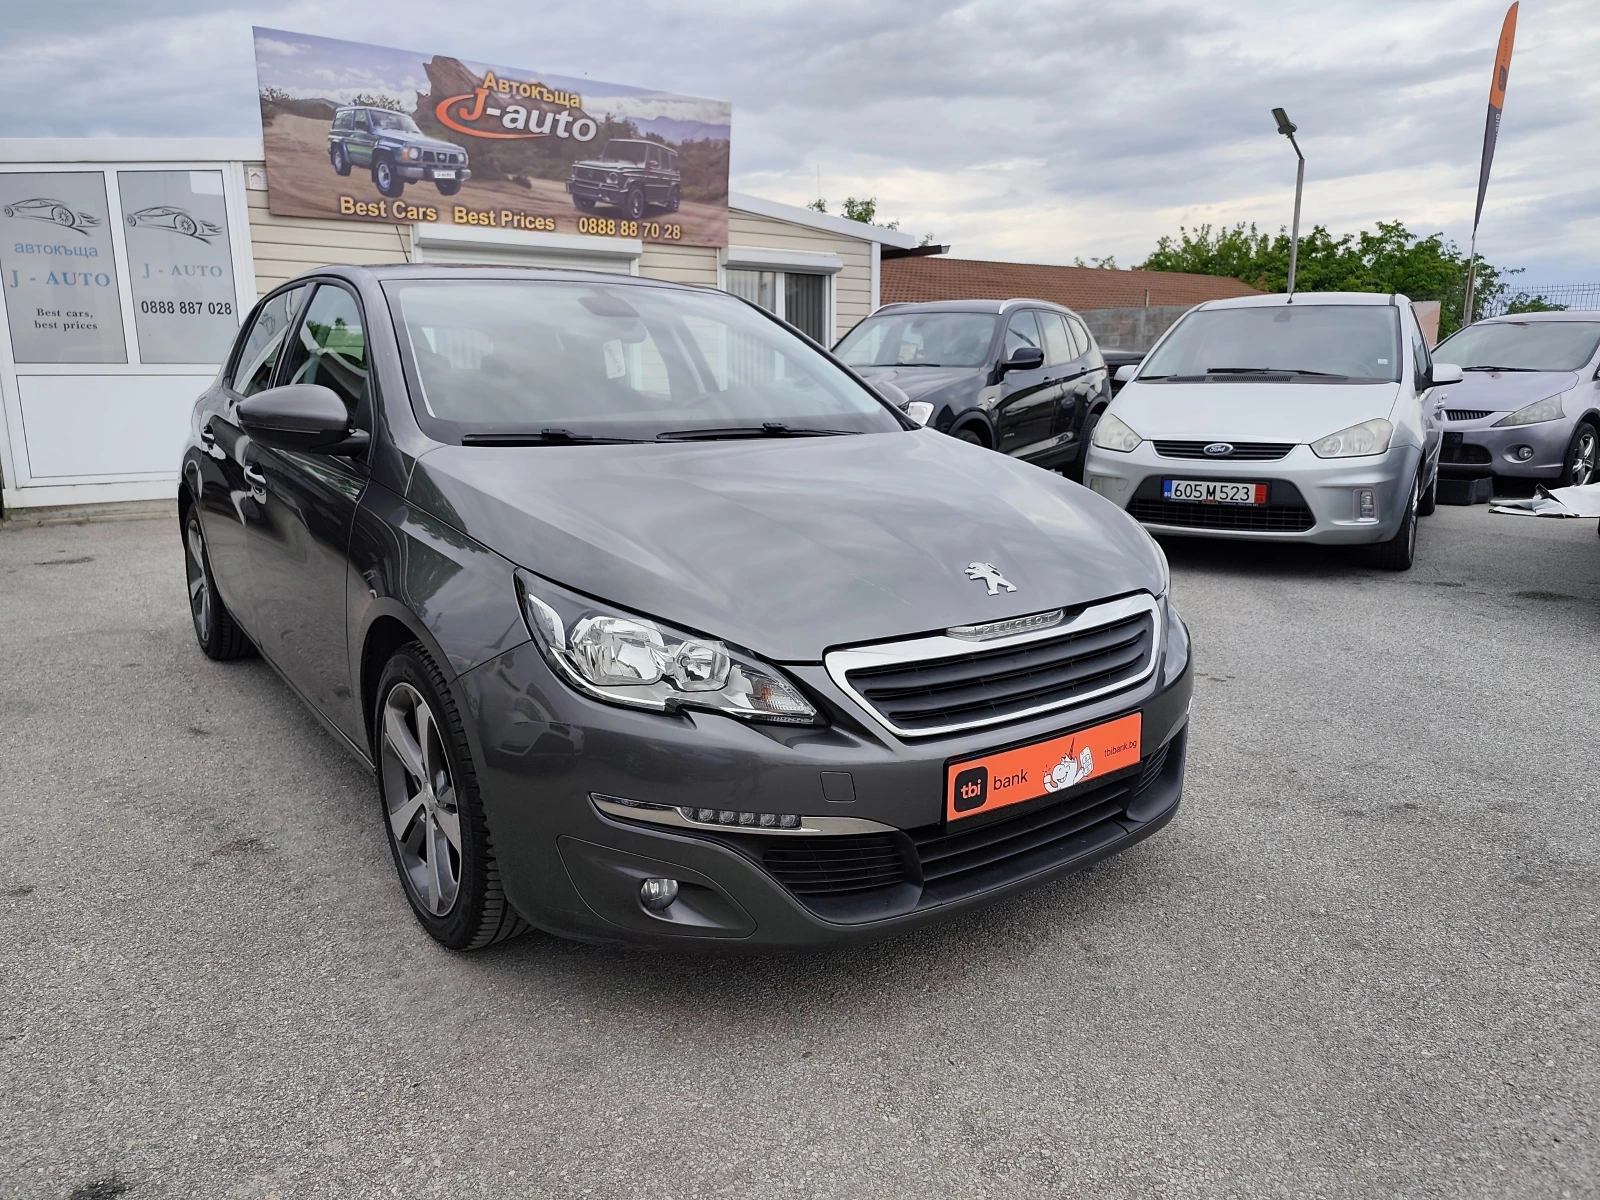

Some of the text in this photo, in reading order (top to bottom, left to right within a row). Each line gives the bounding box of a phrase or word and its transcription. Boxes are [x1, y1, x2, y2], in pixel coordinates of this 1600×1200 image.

[482, 72, 581, 108] Автокъща
[459, 88, 597, 142] J-auto
[340, 196, 555, 231] Best Cars Best Prices
[579, 217, 681, 239] 0888 88 70 28
[14, 243, 98, 258] автокъща
[46, 271, 111, 287] AUTO
[171, 264, 223, 277] AUTO
[36, 308, 93, 319] Best cars,
[141, 300, 232, 315] 0888 887 028
[34, 320, 98, 332] best prices
[982, 614, 1054, 634] PEUGEOT
[1104, 740, 1137, 758] tbibank.bg
[960, 768, 1028, 799] tbi bank
